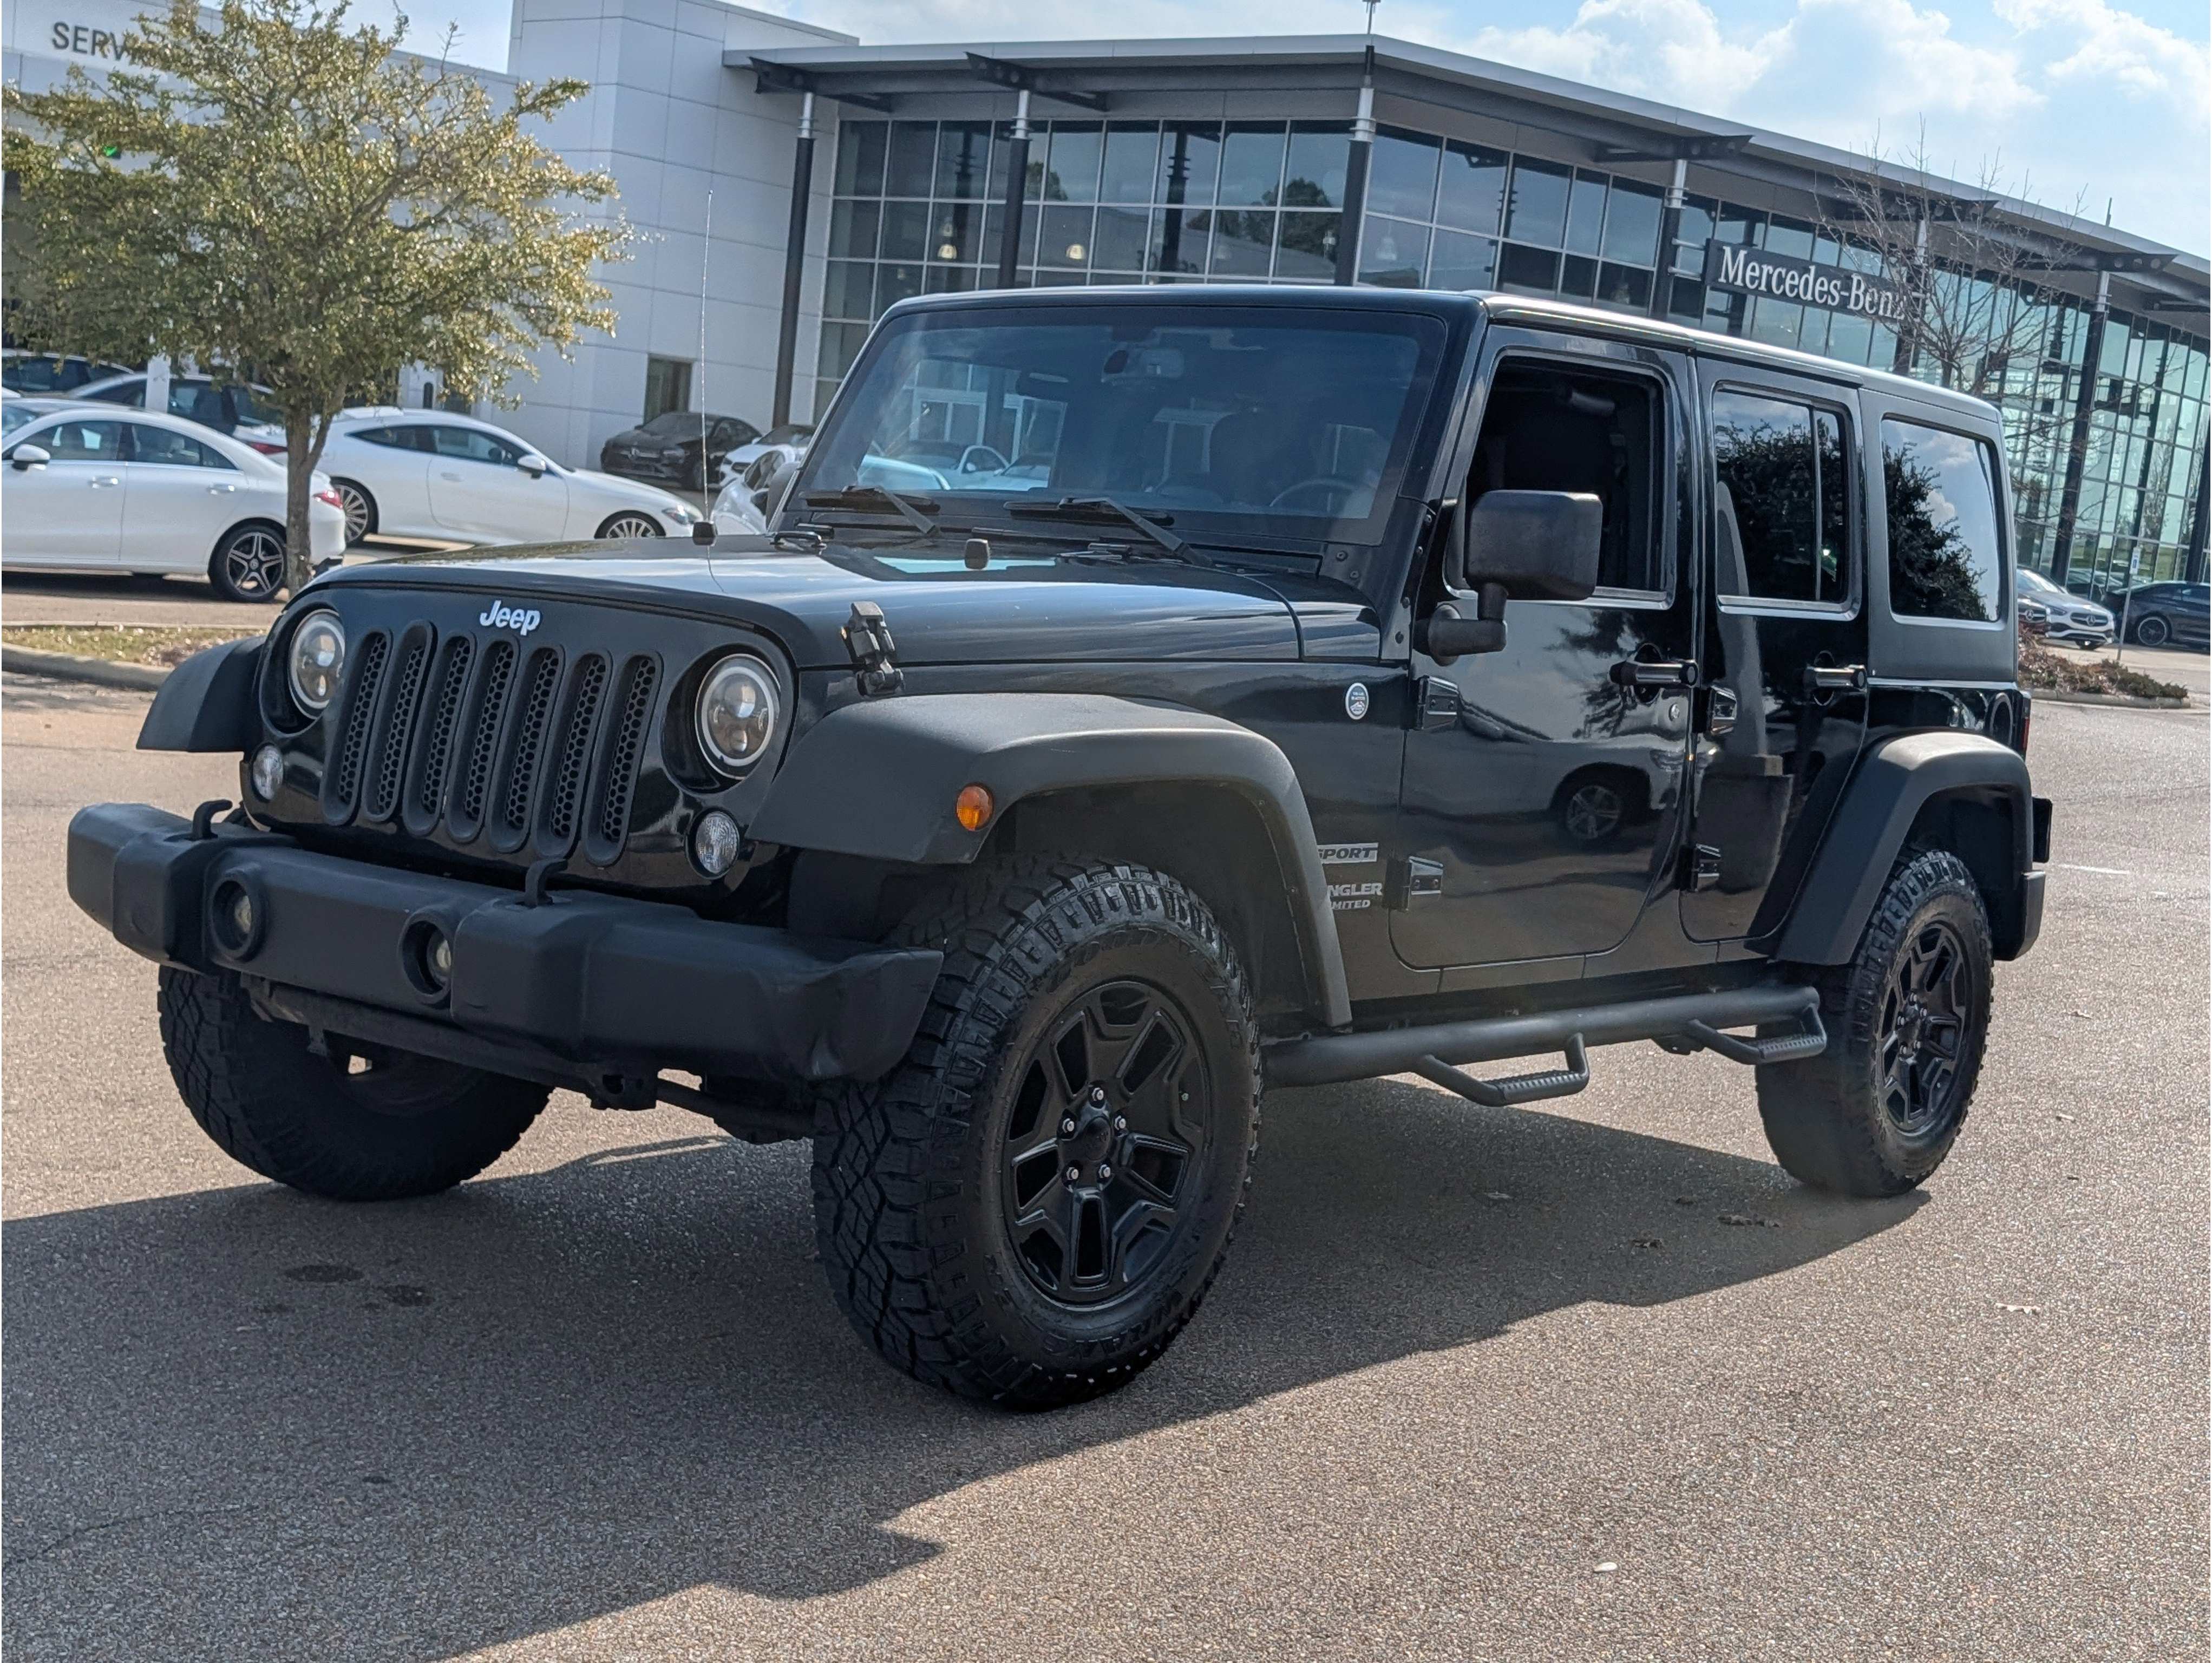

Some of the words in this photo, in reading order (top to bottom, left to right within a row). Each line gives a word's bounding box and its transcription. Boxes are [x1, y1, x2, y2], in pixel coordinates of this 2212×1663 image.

[53, 22, 127, 61] SERV
[1718, 246, 1906, 320] Mercedes-Benz
[480, 600, 540, 636] Jeep
[1327, 883, 1383, 896] NGLER
